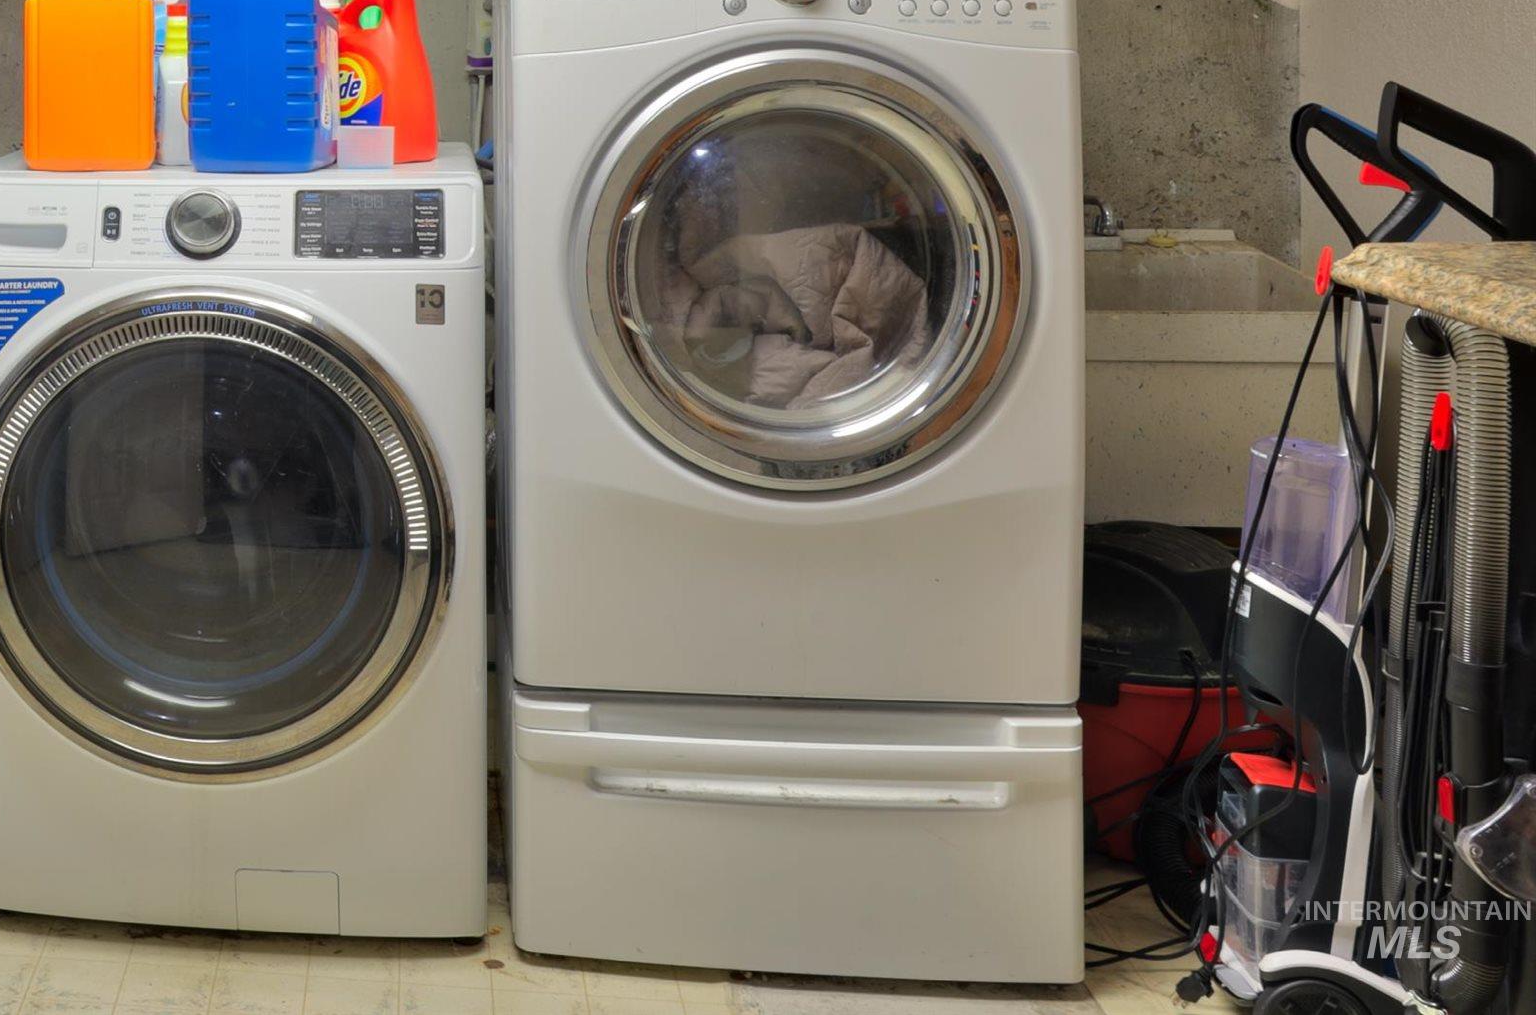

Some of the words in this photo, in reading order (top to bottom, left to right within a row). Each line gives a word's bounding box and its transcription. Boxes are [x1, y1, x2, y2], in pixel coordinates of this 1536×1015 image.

[23, 281, 59, 290] LAUNDRY
[141, 300, 193, 316] ULTRAFRESH
[197, 300, 219, 311] VENT
[224, 305, 257, 318] SYSTEM
